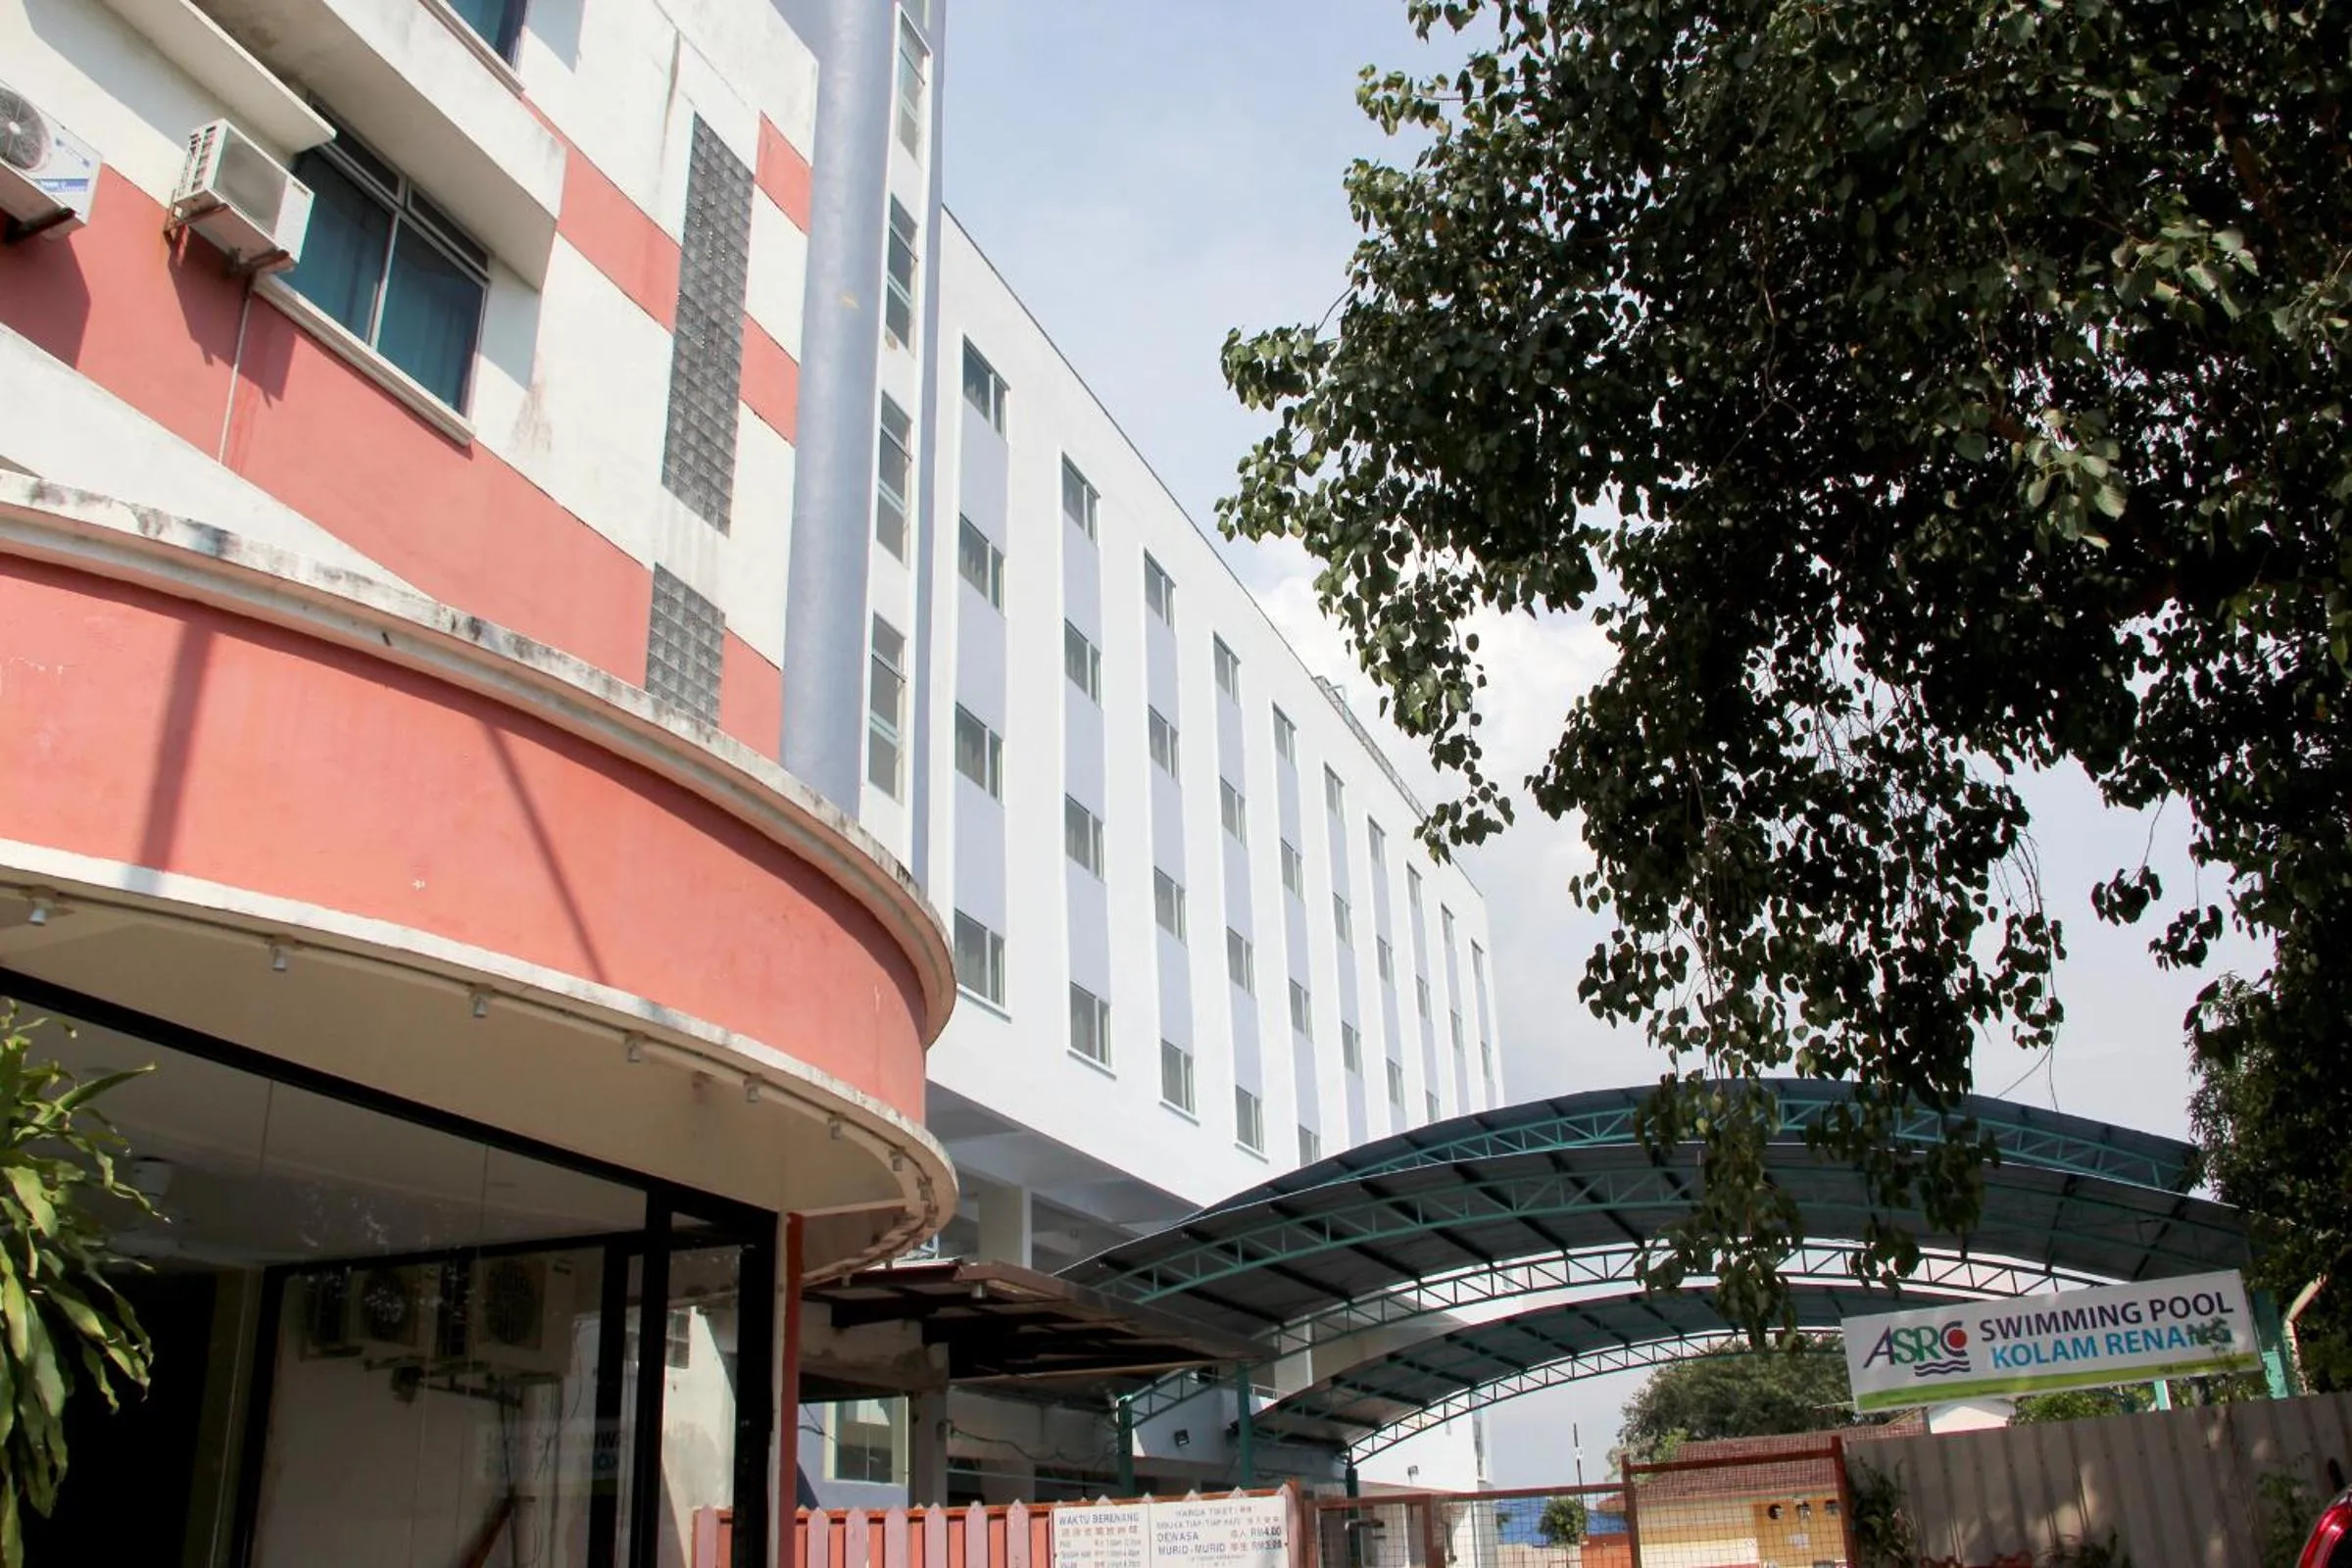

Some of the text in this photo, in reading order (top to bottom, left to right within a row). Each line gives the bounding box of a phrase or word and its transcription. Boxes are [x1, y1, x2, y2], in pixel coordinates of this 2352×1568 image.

[1980, 1292, 2233, 1343] SWIMMING POOL
[1863, 1321, 1969, 1369] ASRC
[1991, 1336, 2098, 1369] KOLAM
[1059, 1512, 1140, 1526] WAKTU BERENANG
[1157, 1532, 1200, 1543] DEWASA
